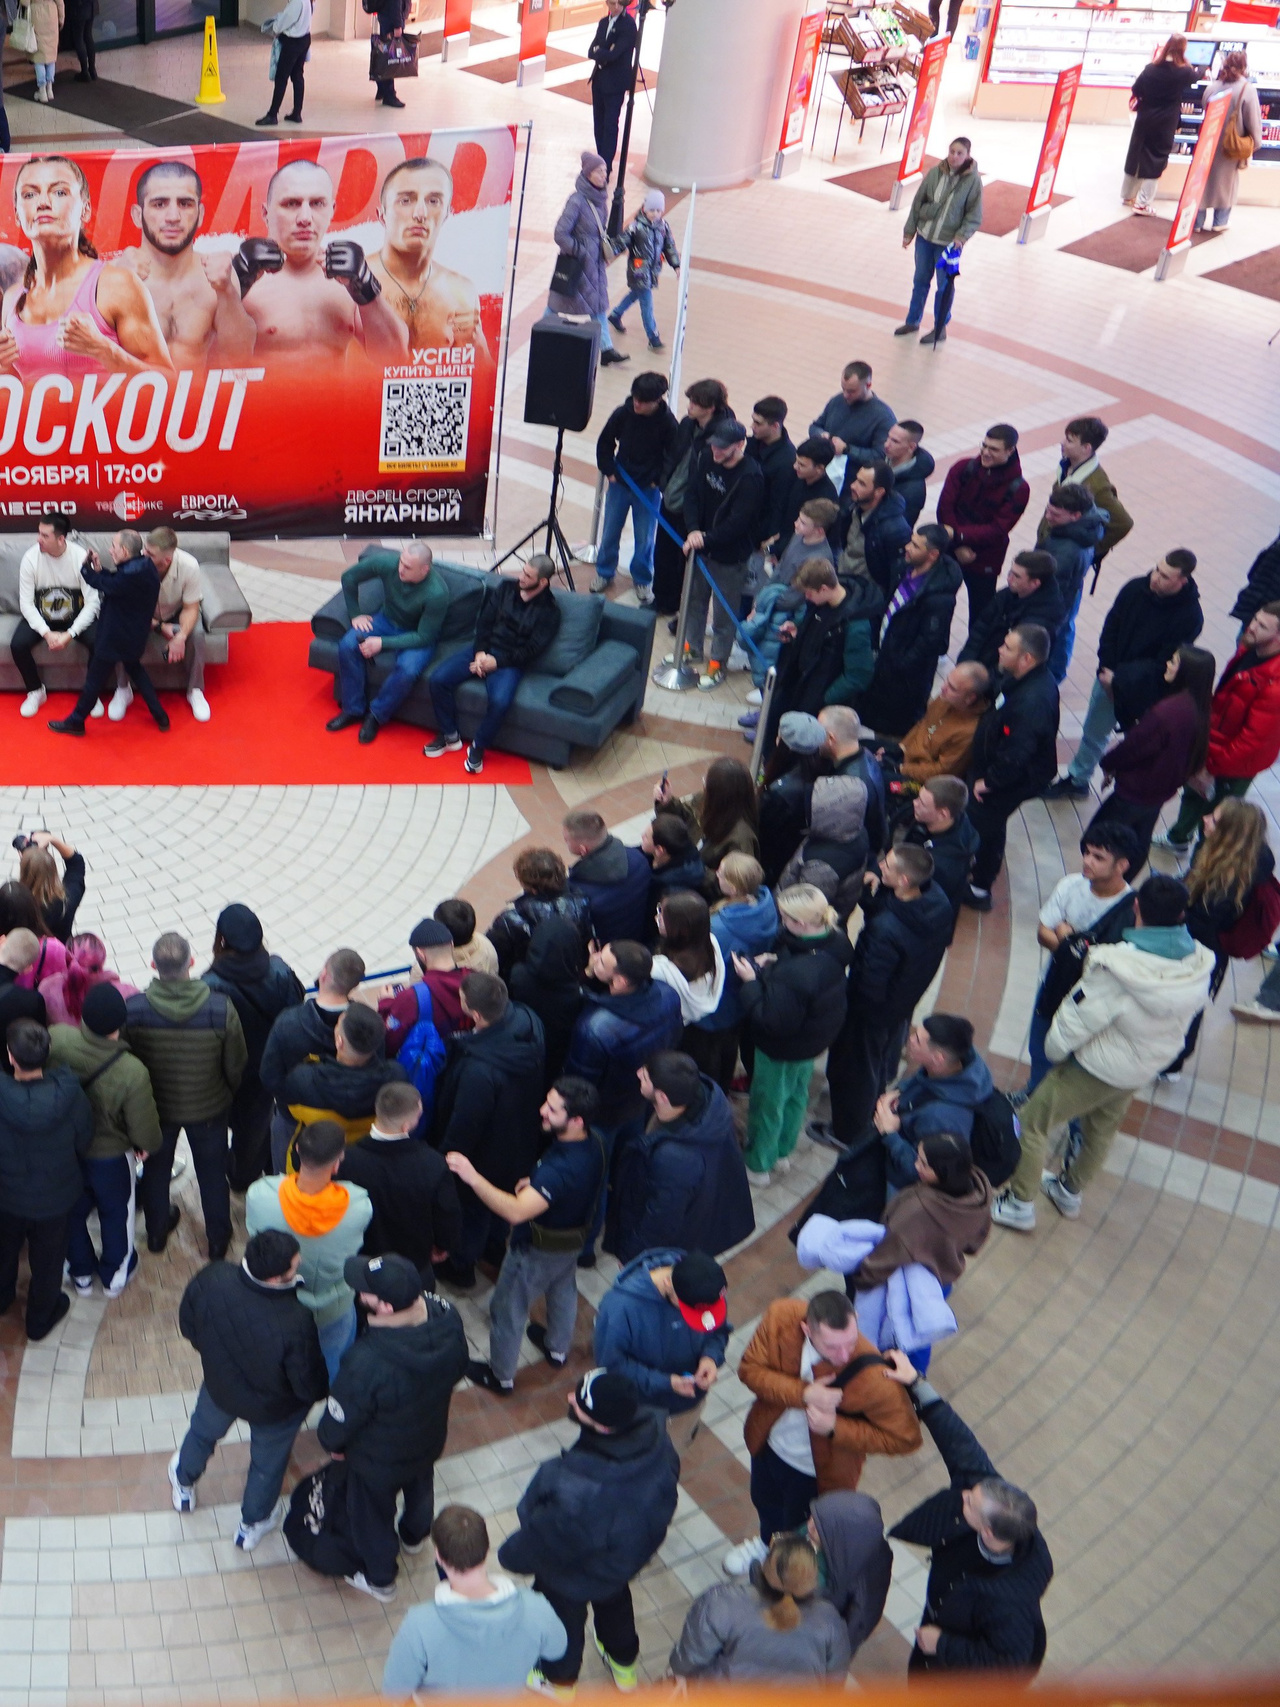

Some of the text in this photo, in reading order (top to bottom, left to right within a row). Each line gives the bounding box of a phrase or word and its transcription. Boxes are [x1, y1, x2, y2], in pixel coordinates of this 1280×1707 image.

[412, 343, 475, 365] УСПЕЙ
[384, 364, 475, 378] КУПИТЬ БИЛЕТ
[104, 463, 163, 484] 17:00
[181, 494, 239, 510] ЕВРОПА
[345, 488, 462, 505] ДВОРЕЦ СПОРТА
[344, 500, 461, 523] ЯНТАРНЫЙ
